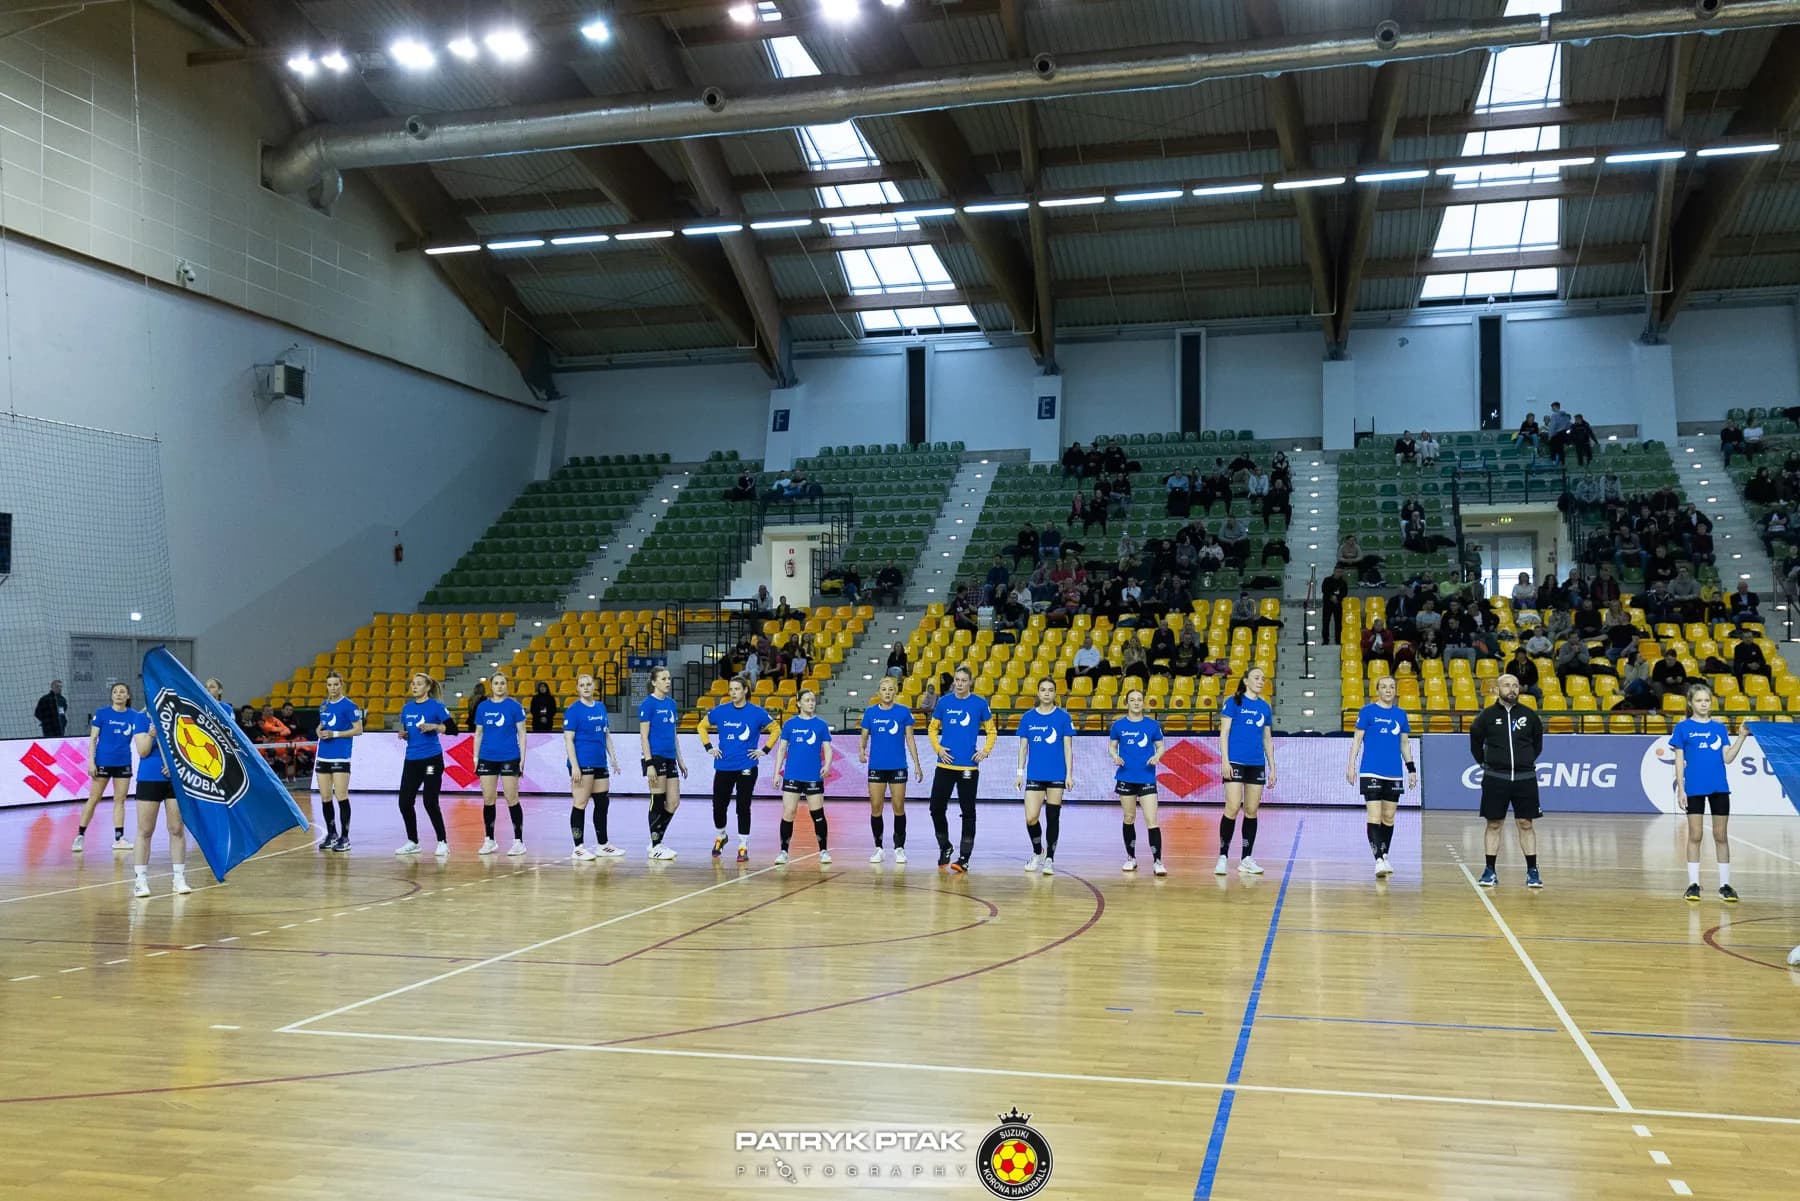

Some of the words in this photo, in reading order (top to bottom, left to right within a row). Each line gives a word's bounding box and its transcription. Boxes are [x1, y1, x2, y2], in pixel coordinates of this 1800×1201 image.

[1041, 398, 1053, 418] E
[775, 411, 787, 430] F
[173, 758, 220, 794] HANDBA
[1534, 762, 1618, 788] GNiG
